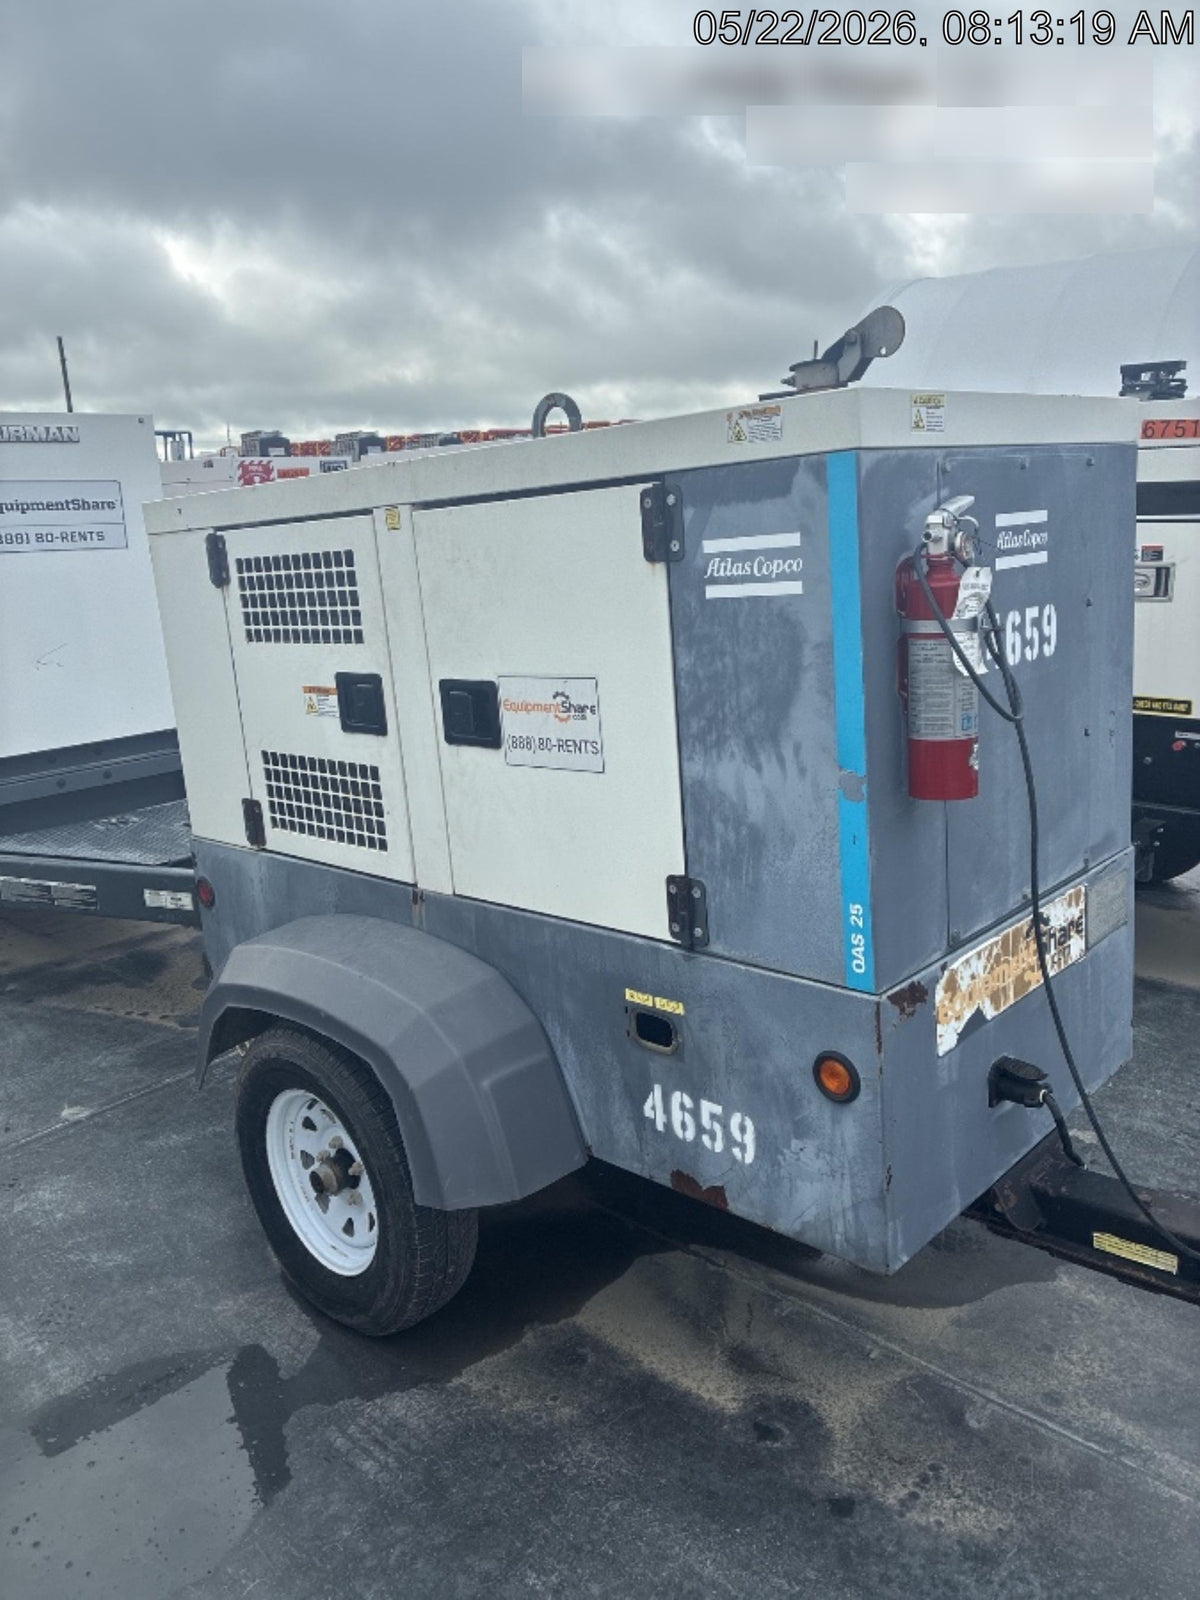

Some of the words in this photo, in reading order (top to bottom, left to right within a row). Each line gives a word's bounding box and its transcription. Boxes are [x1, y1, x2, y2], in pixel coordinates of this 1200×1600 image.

[0, 425, 79, 443] IRMAN
[0, 499, 116, 514] quipmentShare
[34, 531, 105, 543] 80-RENTS
[704, 557, 752, 579] Atlas
[753, 555, 803, 579] Copco
[849, 903, 864, 929] 25
[643, 1083, 756, 1165] 4659
